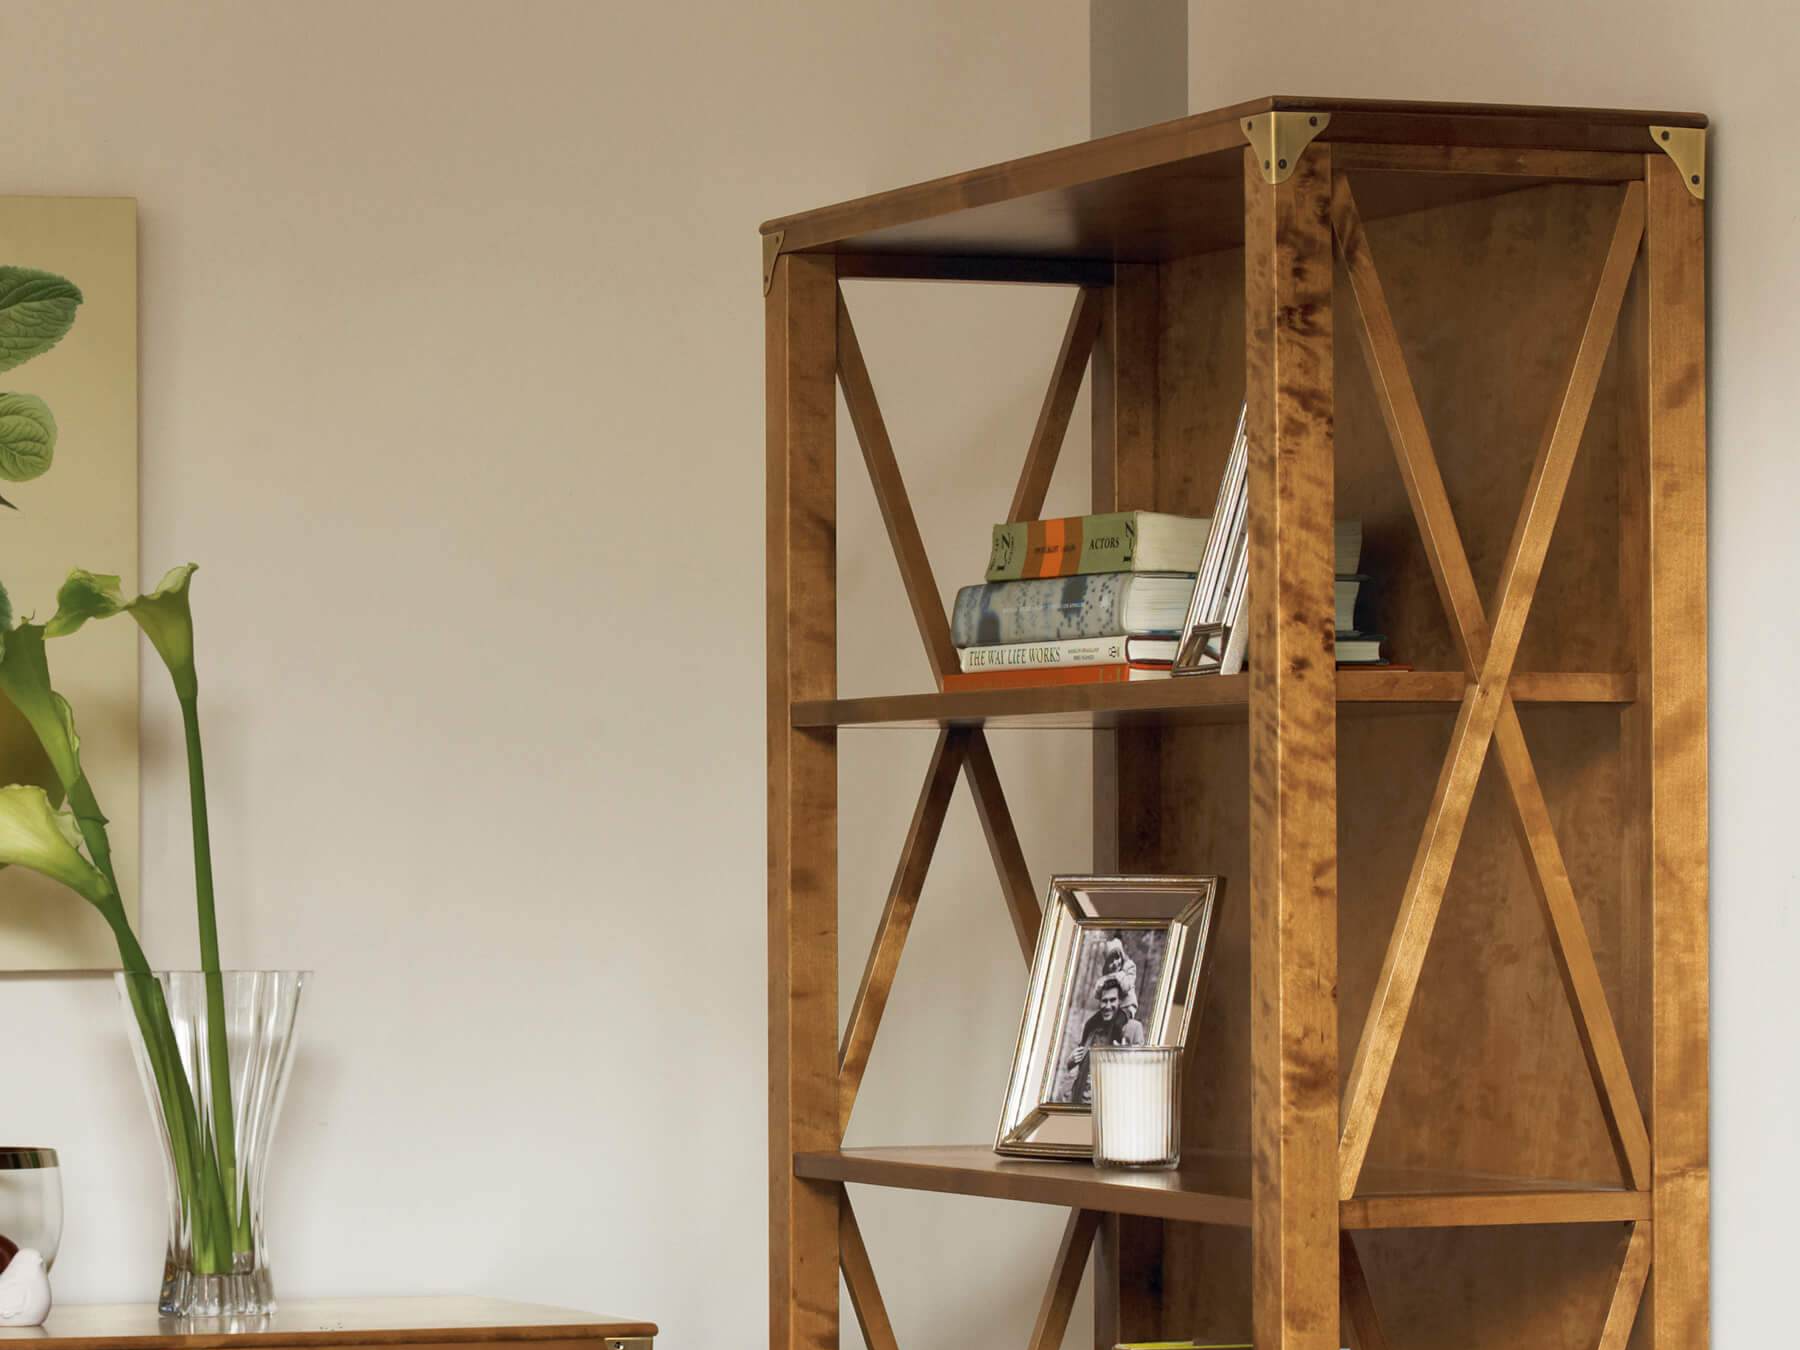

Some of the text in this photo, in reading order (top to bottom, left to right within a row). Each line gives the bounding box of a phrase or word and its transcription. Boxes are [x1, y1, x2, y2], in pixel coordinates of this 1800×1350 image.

[1088, 536, 1120, 551] ACTORS
[969, 651, 985, 666] THE
[987, 650, 1006, 665] WAY
[1007, 649, 1027, 664] LIFE
[1028, 648, 1061, 663] WORKS
